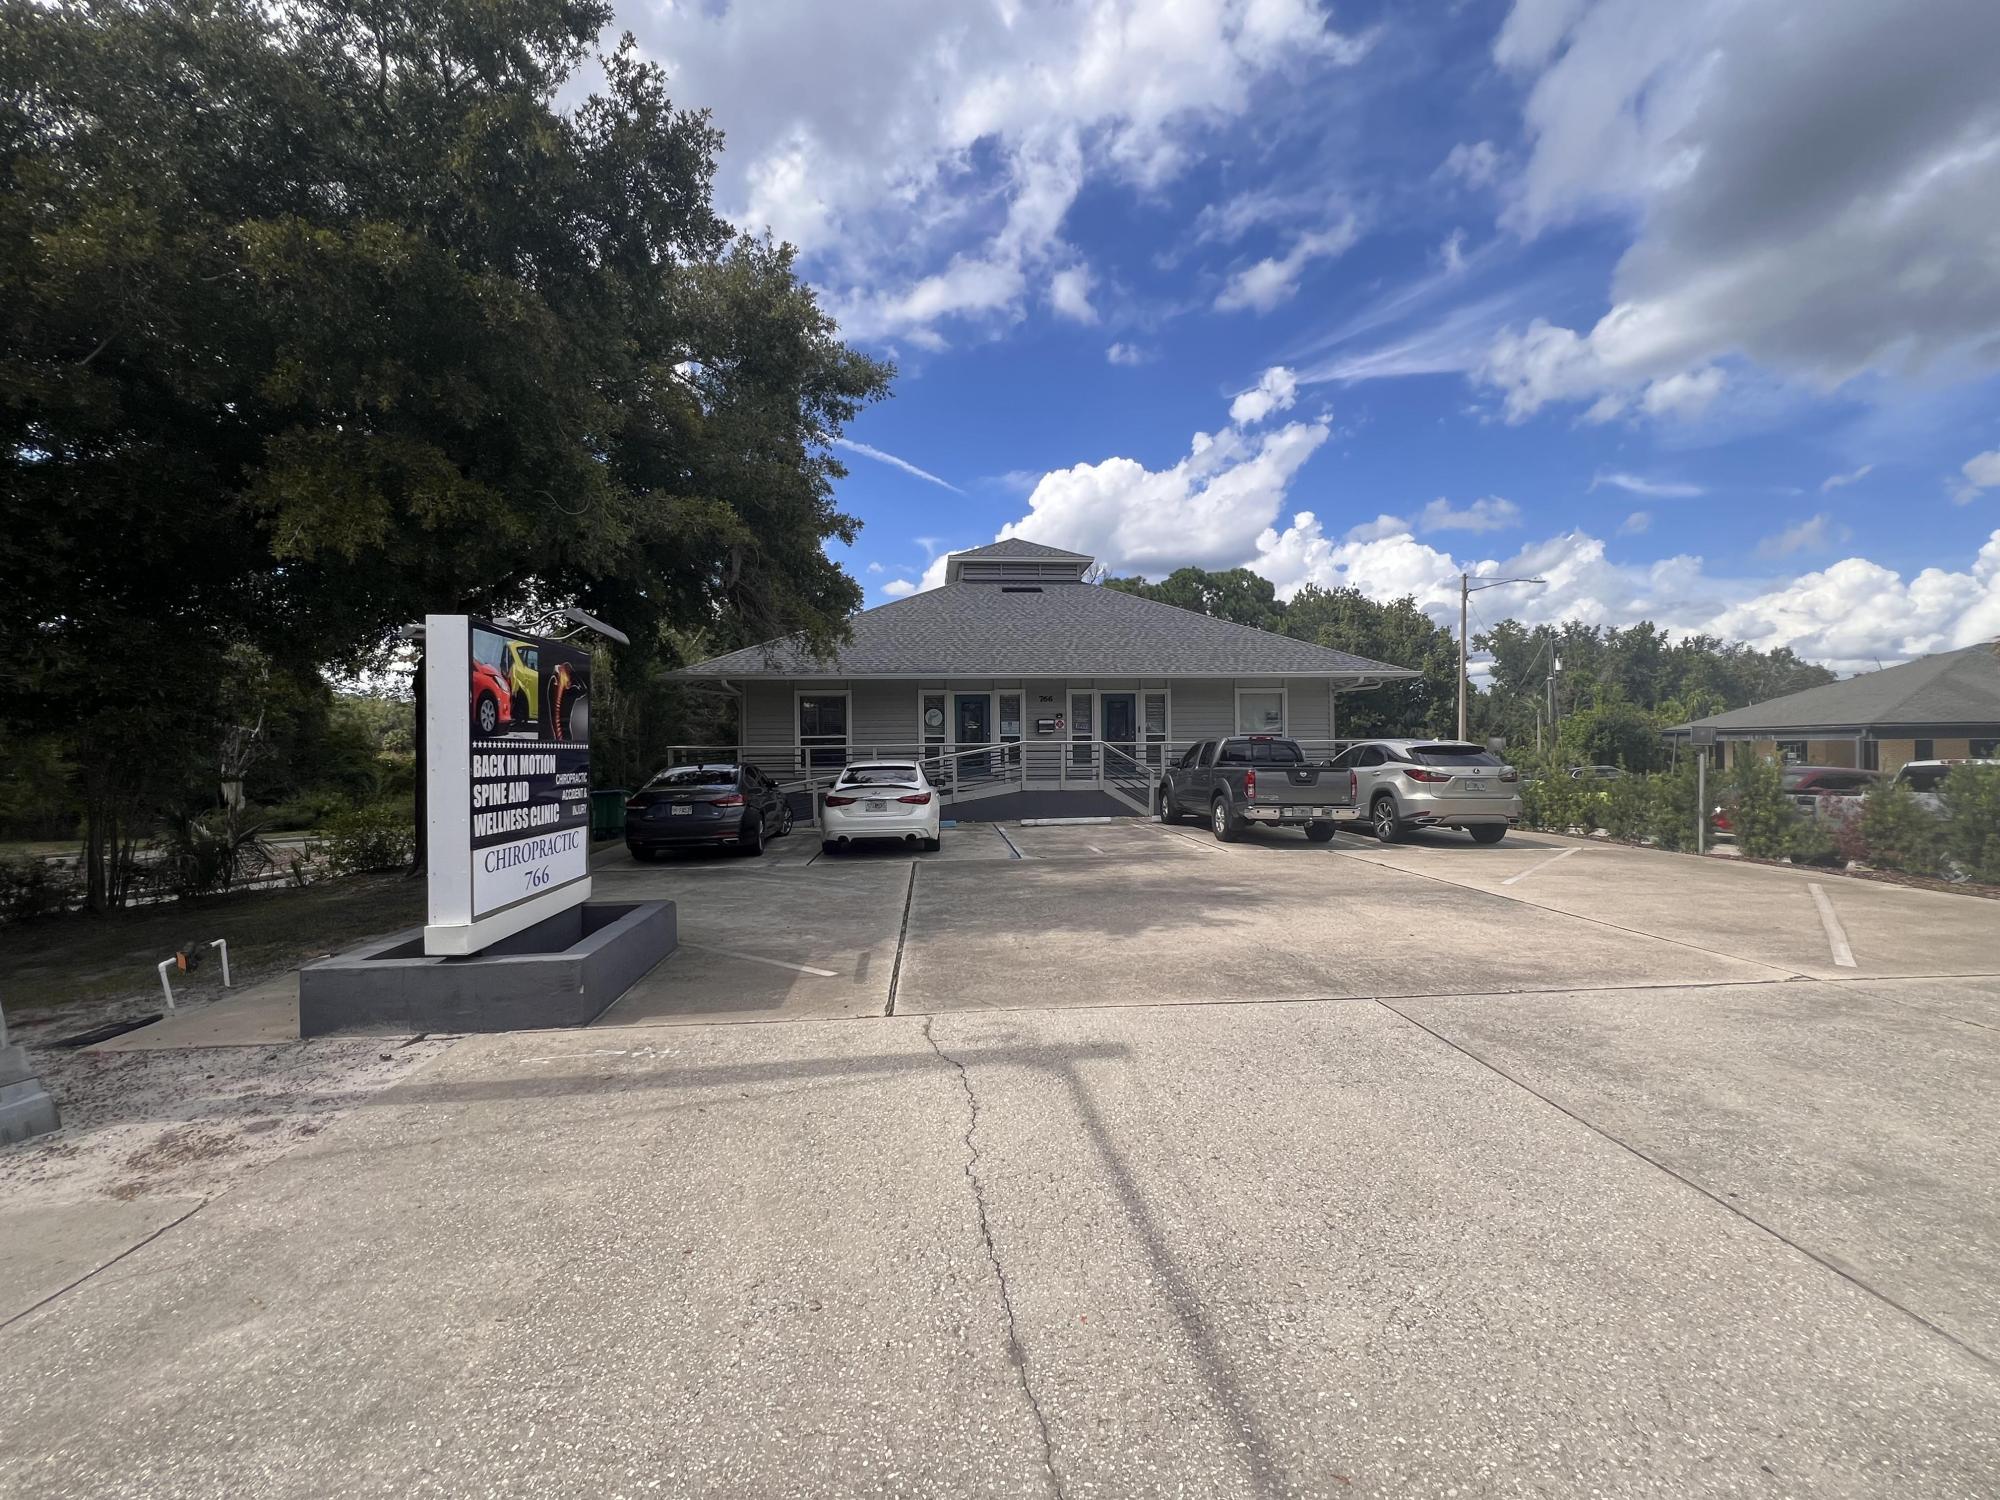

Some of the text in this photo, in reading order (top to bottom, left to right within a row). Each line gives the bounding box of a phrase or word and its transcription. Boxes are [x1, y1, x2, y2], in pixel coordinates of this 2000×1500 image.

[473, 754, 556, 778] BACK IN MOTION
[473, 781, 530, 808] SPINE AND
[473, 803, 560, 837] WELLNESS CLINIC
[484, 830, 579, 873] CHIROPRACTIC
[525, 865, 550, 890] 766
